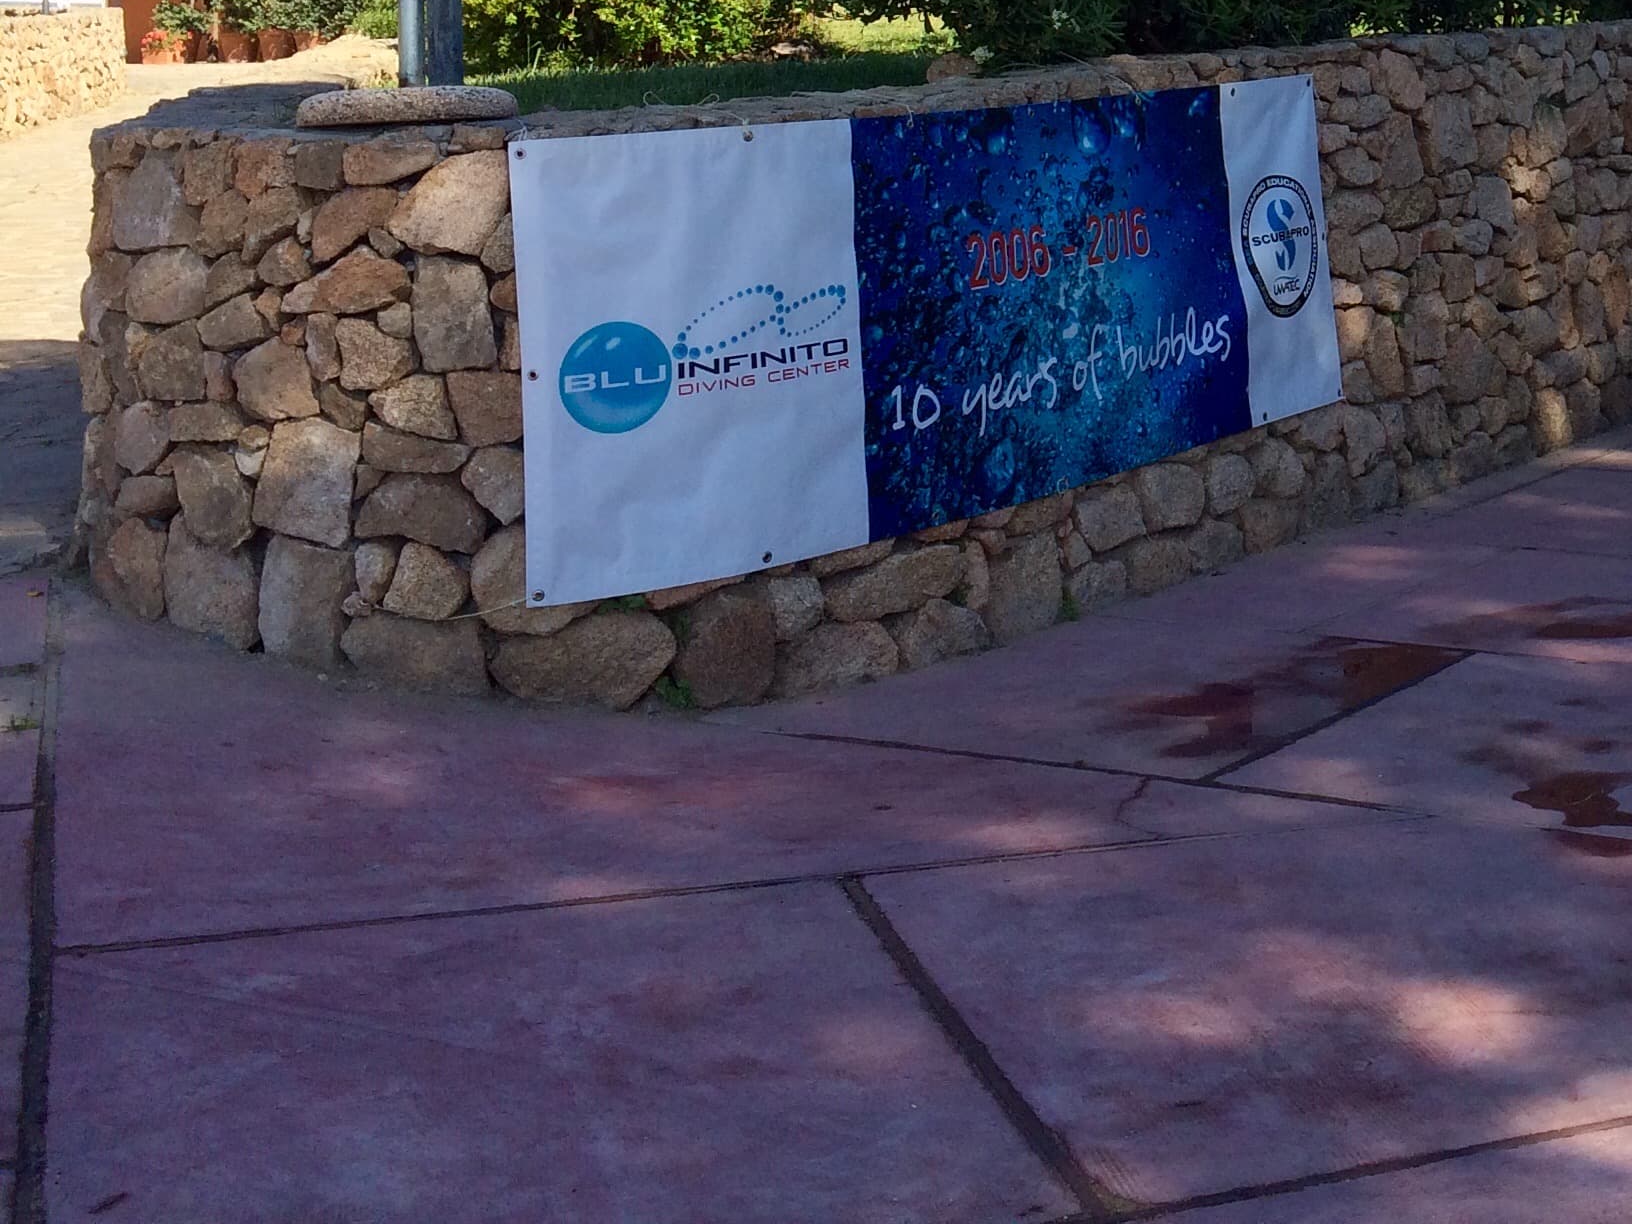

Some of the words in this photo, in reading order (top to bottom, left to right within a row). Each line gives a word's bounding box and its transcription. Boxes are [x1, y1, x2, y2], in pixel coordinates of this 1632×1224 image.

[966, 224, 1051, 290] 2006
[1086, 206, 1151, 268] 2016
[1252, 225, 1310, 247] SCUBAPRO
[563, 363, 667, 394] BLU
[677, 338, 849, 380] INFINITO
[677, 374, 756, 397] DIVING
[767, 358, 850, 384] CENTER
[891, 383, 941, 431] 10
[962, 356, 1058, 437] years
[1072, 323, 1106, 400] of
[1116, 306, 1231, 380] bubbles
